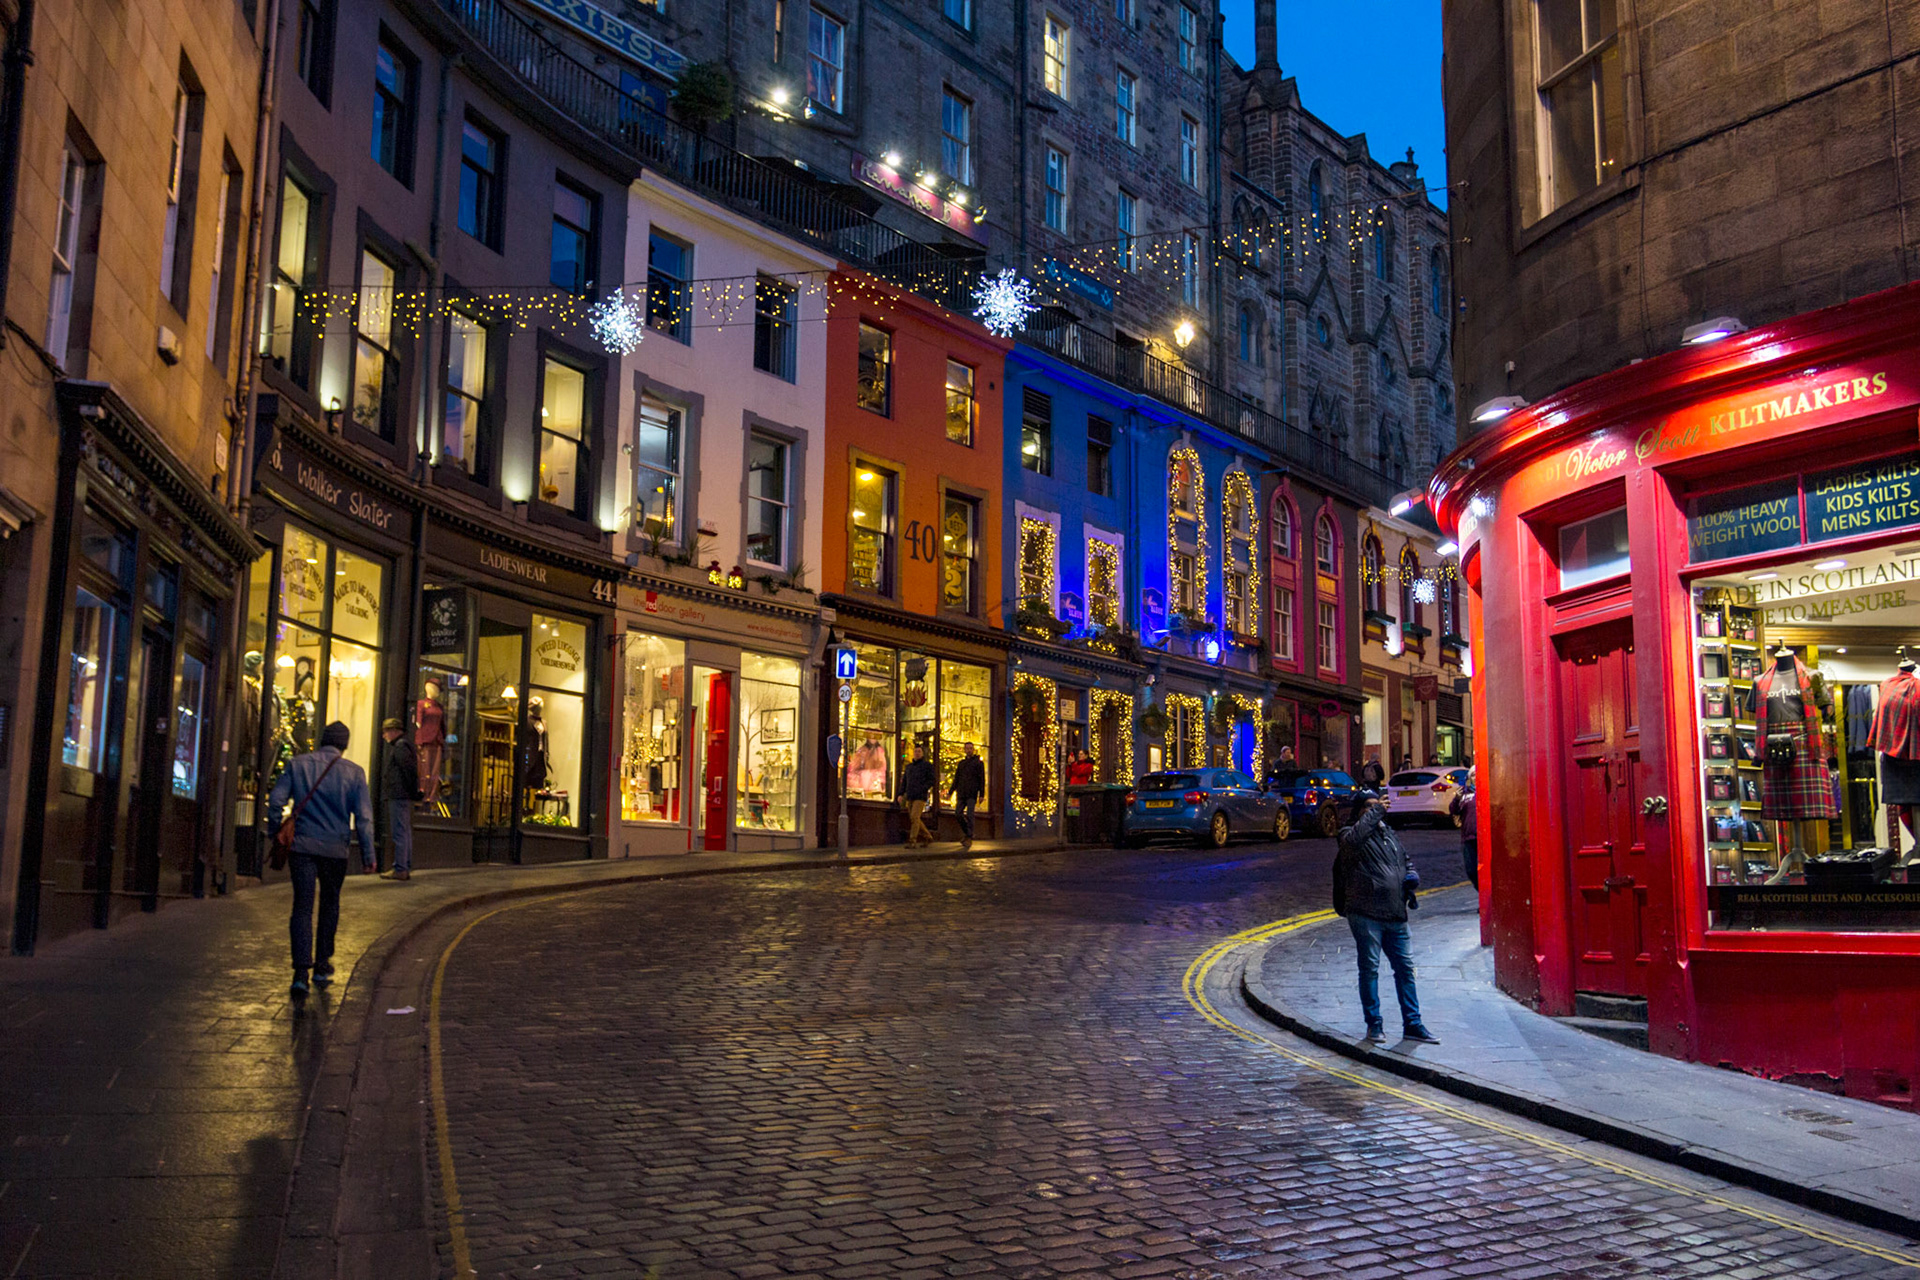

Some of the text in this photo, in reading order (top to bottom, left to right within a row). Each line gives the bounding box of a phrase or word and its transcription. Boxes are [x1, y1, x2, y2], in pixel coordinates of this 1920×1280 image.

[544, 0, 653, 60] XIES
[1565, 438, 1627, 481] Victor
[1635, 421, 1699, 465] Scott
[1709, 372, 1888, 436] KILTMAKERS
[297, 461, 392, 528] Walker Slater
[1816, 460, 1920, 496] LADIES KILTS
[1696, 498, 1789, 530] 100% HEAVY
[1826, 482, 1911, 513] KIDS KILTS
[1689, 515, 1800, 548] WEIGHT WOOL
[1822, 500, 1920, 533] MENS KILTS
[904, 520, 936, 563] 40
[480, 548, 547, 583] LADIESWEAR
[945, 569, 962, 598] 2
[1702, 583, 1764, 609] MADE
[1770, 578, 1792, 599] IN
[658, 601, 676, 614] door
[679, 607, 706, 623] gallery
[1778, 605, 1806, 623] TO
[1811, 589, 1906, 618] MEASURE
[840, 688, 851, 698] 20
[1737, 893, 1760, 903] REAL
[1762, 893, 1807, 903] SCOTTISH
[1811, 893, 1838, 903] KILTS
[1840, 893, 1862, 903] AND
